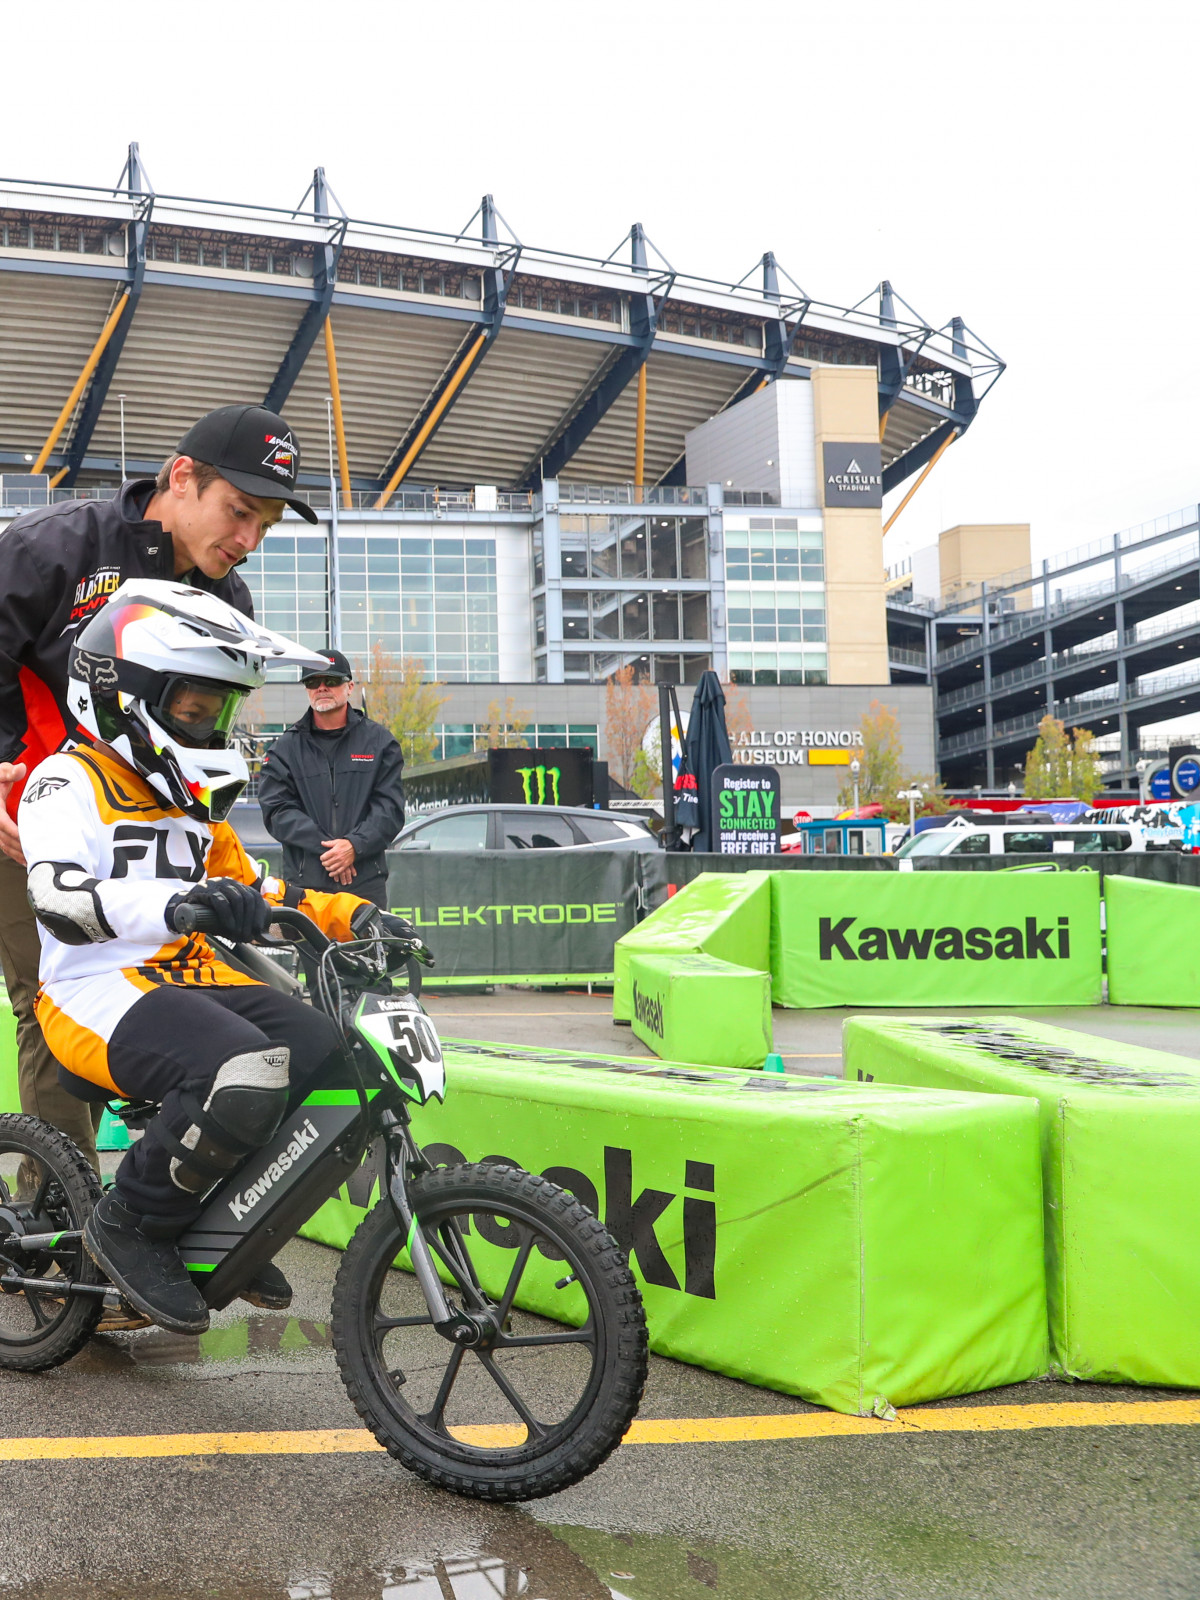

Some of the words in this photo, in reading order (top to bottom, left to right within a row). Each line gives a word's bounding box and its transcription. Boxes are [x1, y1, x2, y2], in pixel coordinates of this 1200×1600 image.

[828, 475, 881, 485] ACRISURE
[838, 484, 871, 492] STADIUM
[74, 572, 120, 606] BLASTER
[774, 731, 796, 746] OF
[801, 731, 864, 746] HONOR
[724, 778, 759, 791] Register
[761, 779, 771, 789] to
[719, 790, 775, 818] STAY
[720, 818, 776, 830] CONNECTED
[720, 830, 736, 840] and
[738, 830, 768, 840] receive
[770, 832, 776, 840] a
[110, 825, 211, 882] FLY
[721, 842, 748, 854] FREE
[751, 842, 776, 854] GIFT
[818, 916, 1071, 961] Kawasaki
[387, 1014, 442, 1064] 50
[228, 1118, 320, 1221] Kawasaki
